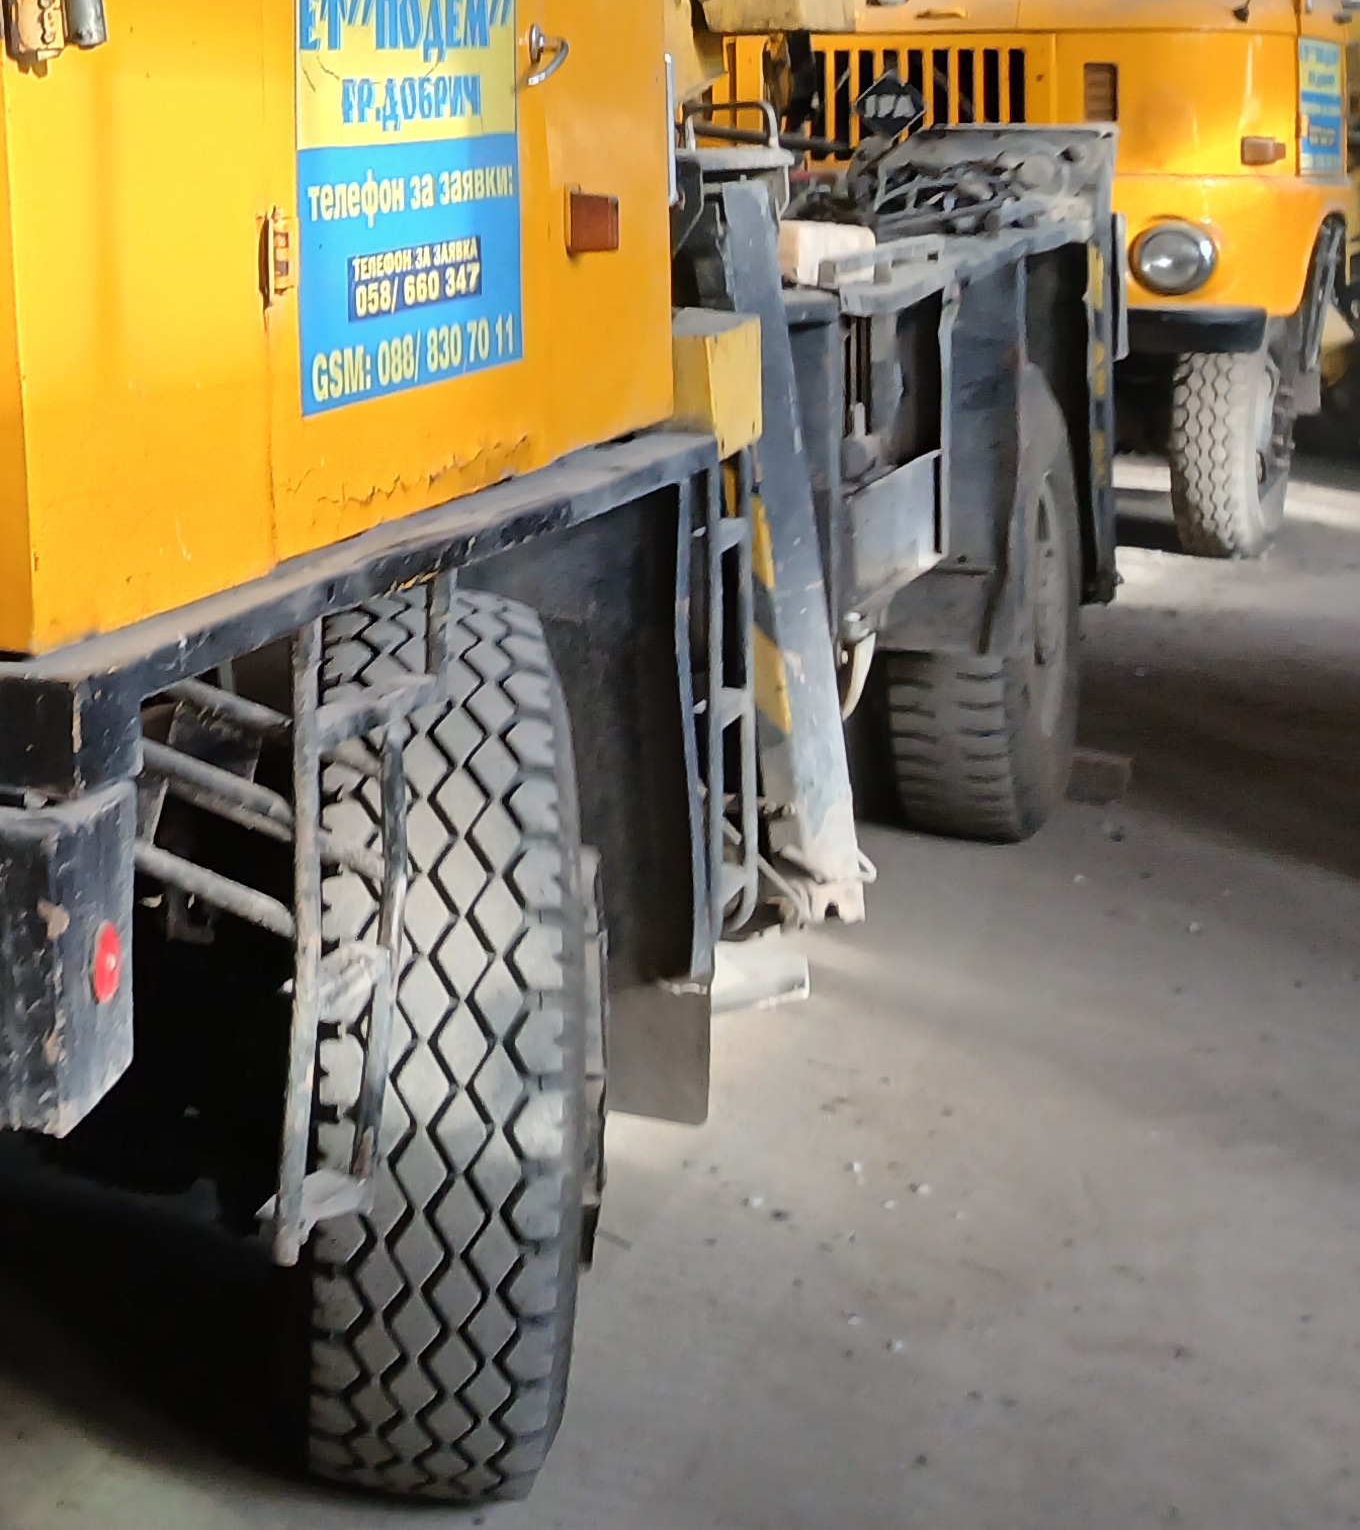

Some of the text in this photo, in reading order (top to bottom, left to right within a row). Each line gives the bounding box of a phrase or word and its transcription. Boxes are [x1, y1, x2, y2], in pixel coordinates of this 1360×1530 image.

[308, 164, 514, 228] телефон за заявки:
[352, 252, 413, 282] ТЕЛЕФОН
[434, 238, 478, 266] ЗАЯВКА
[355, 263, 480, 317] 058/ 660 347
[312, 312, 515, 403] GSM: 088/ 830 70 11
